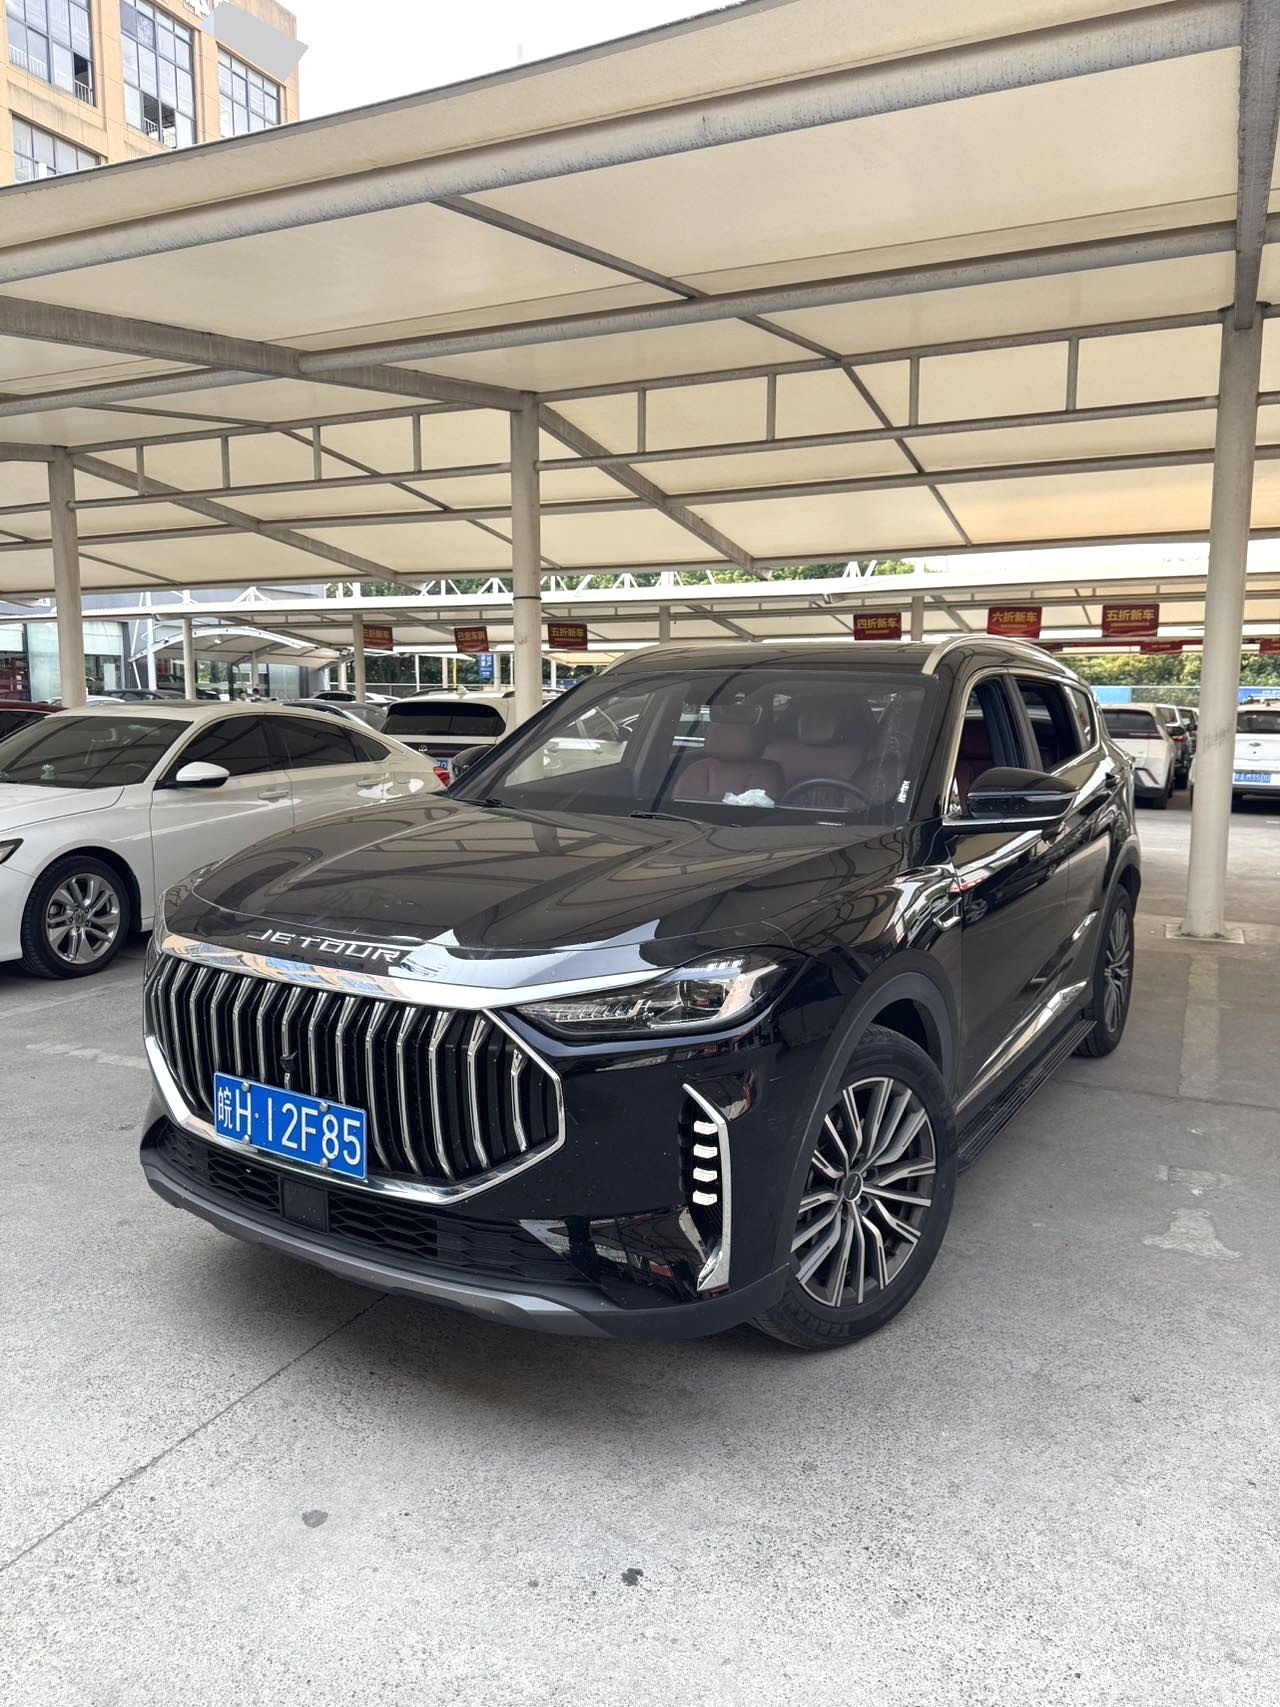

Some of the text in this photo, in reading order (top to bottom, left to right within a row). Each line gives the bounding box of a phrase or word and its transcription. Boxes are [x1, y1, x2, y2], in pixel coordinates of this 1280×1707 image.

[991, 611, 1038, 624] 六折新车
[1106, 608, 1155, 622] 五折新车
[856, 616, 898, 630] 四折新车
[551, 627, 585, 638] 五折新车
[246, 929, 401, 964] JETOUR
